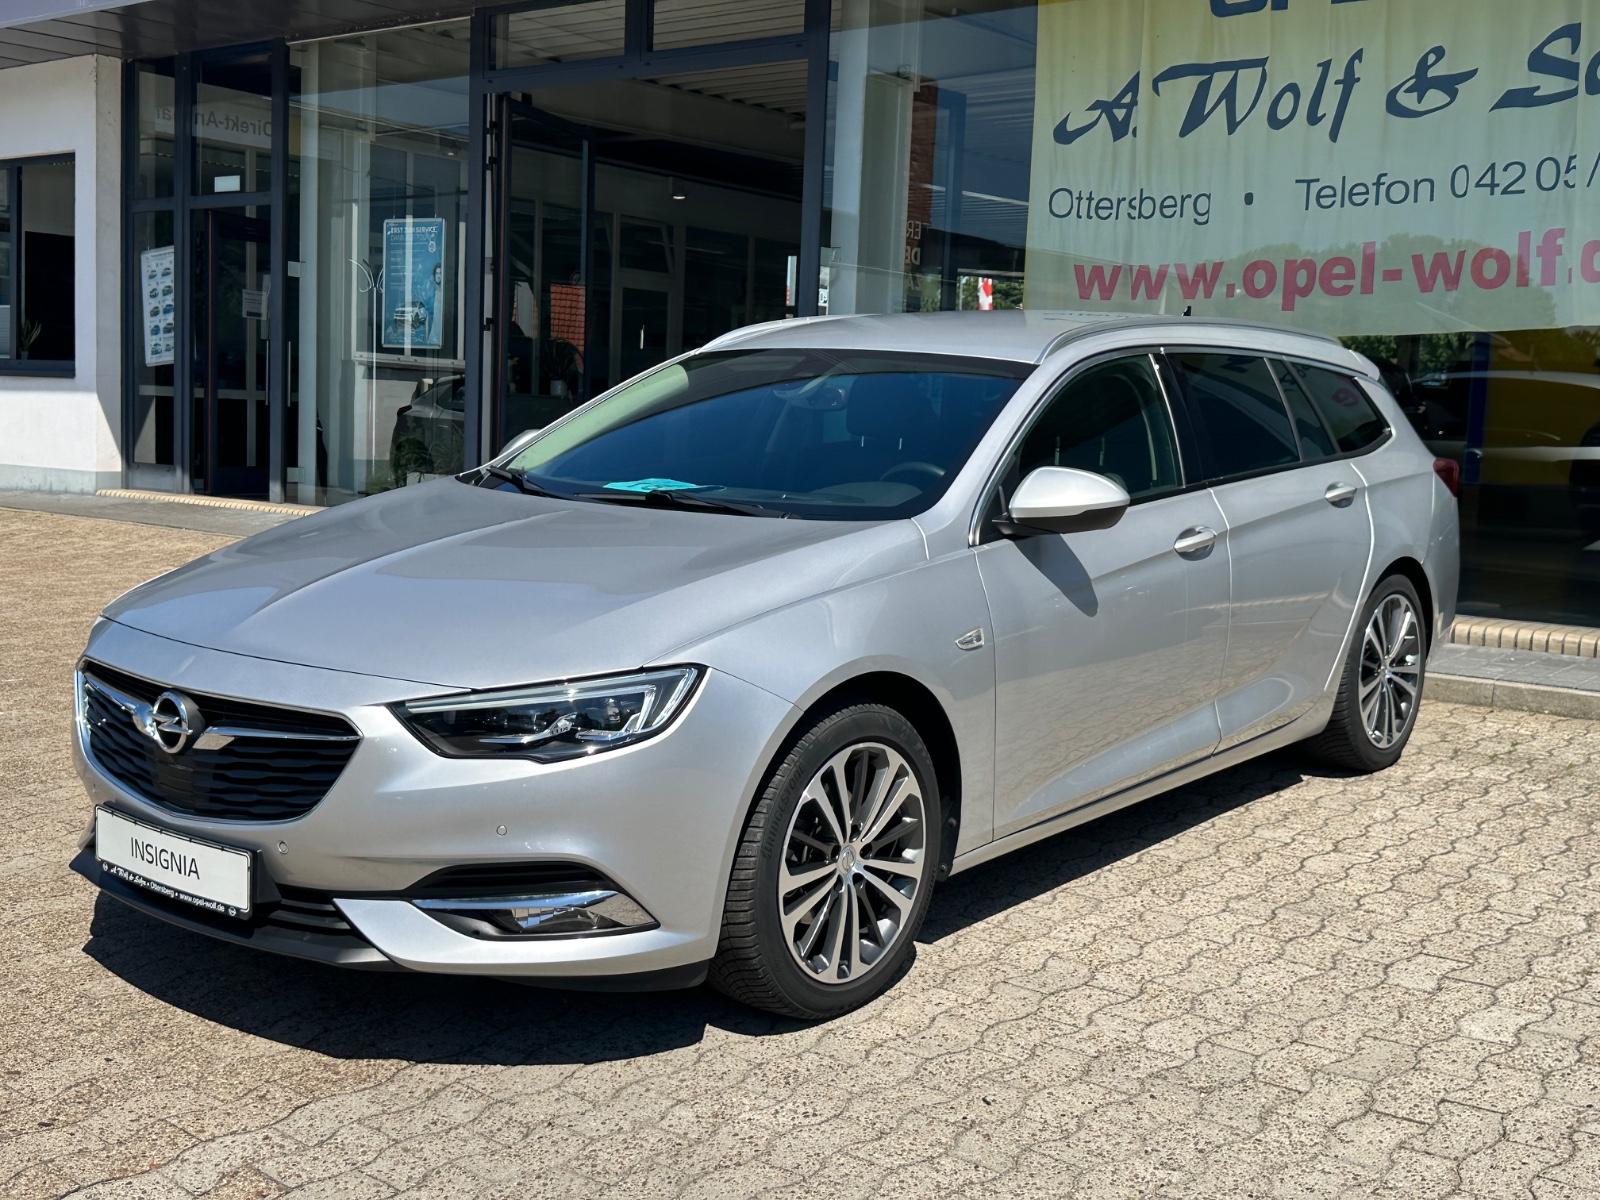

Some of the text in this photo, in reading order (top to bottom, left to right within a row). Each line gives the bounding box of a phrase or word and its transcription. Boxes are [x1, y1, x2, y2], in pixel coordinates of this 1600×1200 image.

[1152, 47, 1365, 144] Wolf
[1386, 45, 1479, 119] &
[1048, 187, 1212, 226] Ottersberg
[1294, 172, 1435, 211] Telefon
[130, 837, 200, 880] INSIGNIA
